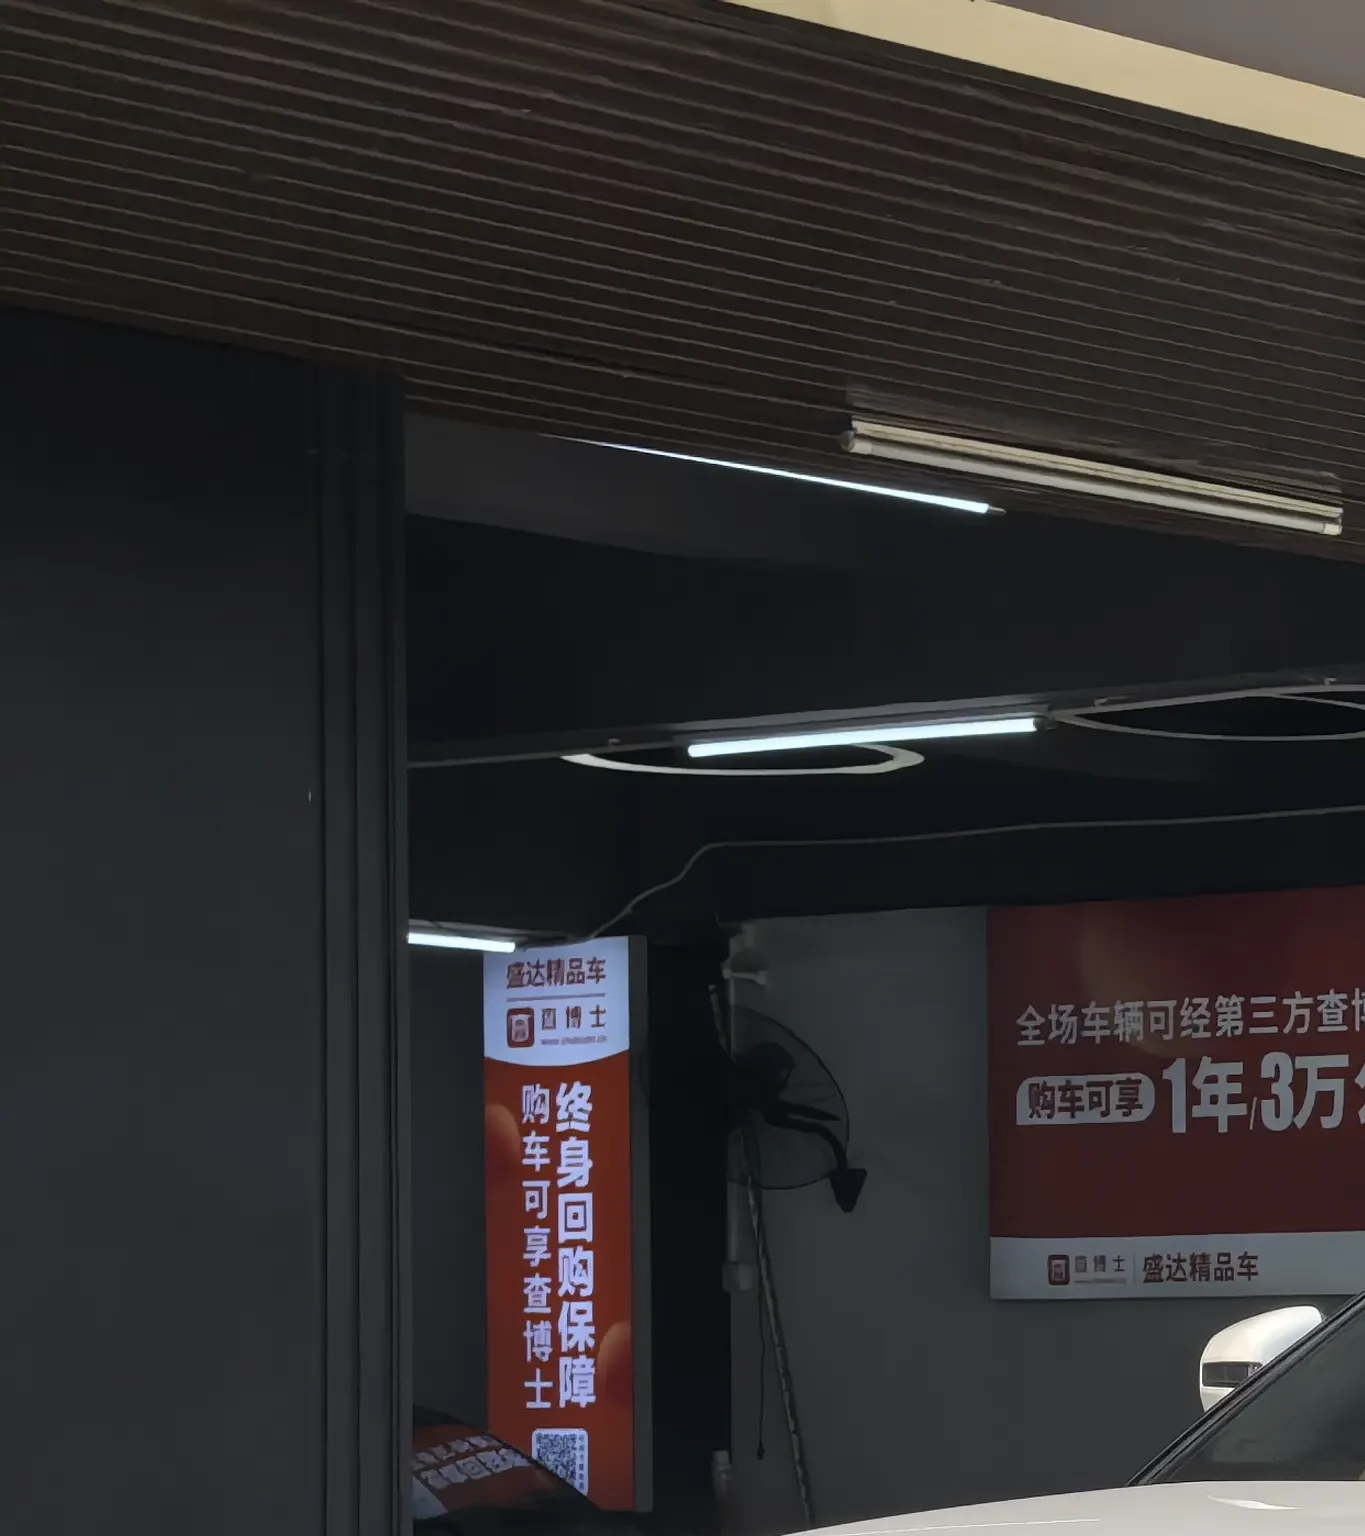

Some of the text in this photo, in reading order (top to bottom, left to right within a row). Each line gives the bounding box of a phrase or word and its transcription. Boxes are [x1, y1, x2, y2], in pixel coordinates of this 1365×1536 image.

[506, 956, 607, 989] 盛达精品车
[1027, 1077, 1145, 1120] 购车可享
[521, 1083, 554, 1410] 购车可享查博士
[555, 1081, 597, 1408] 终身回购保障
[1143, 1251, 1260, 1283] 盛达精品车
